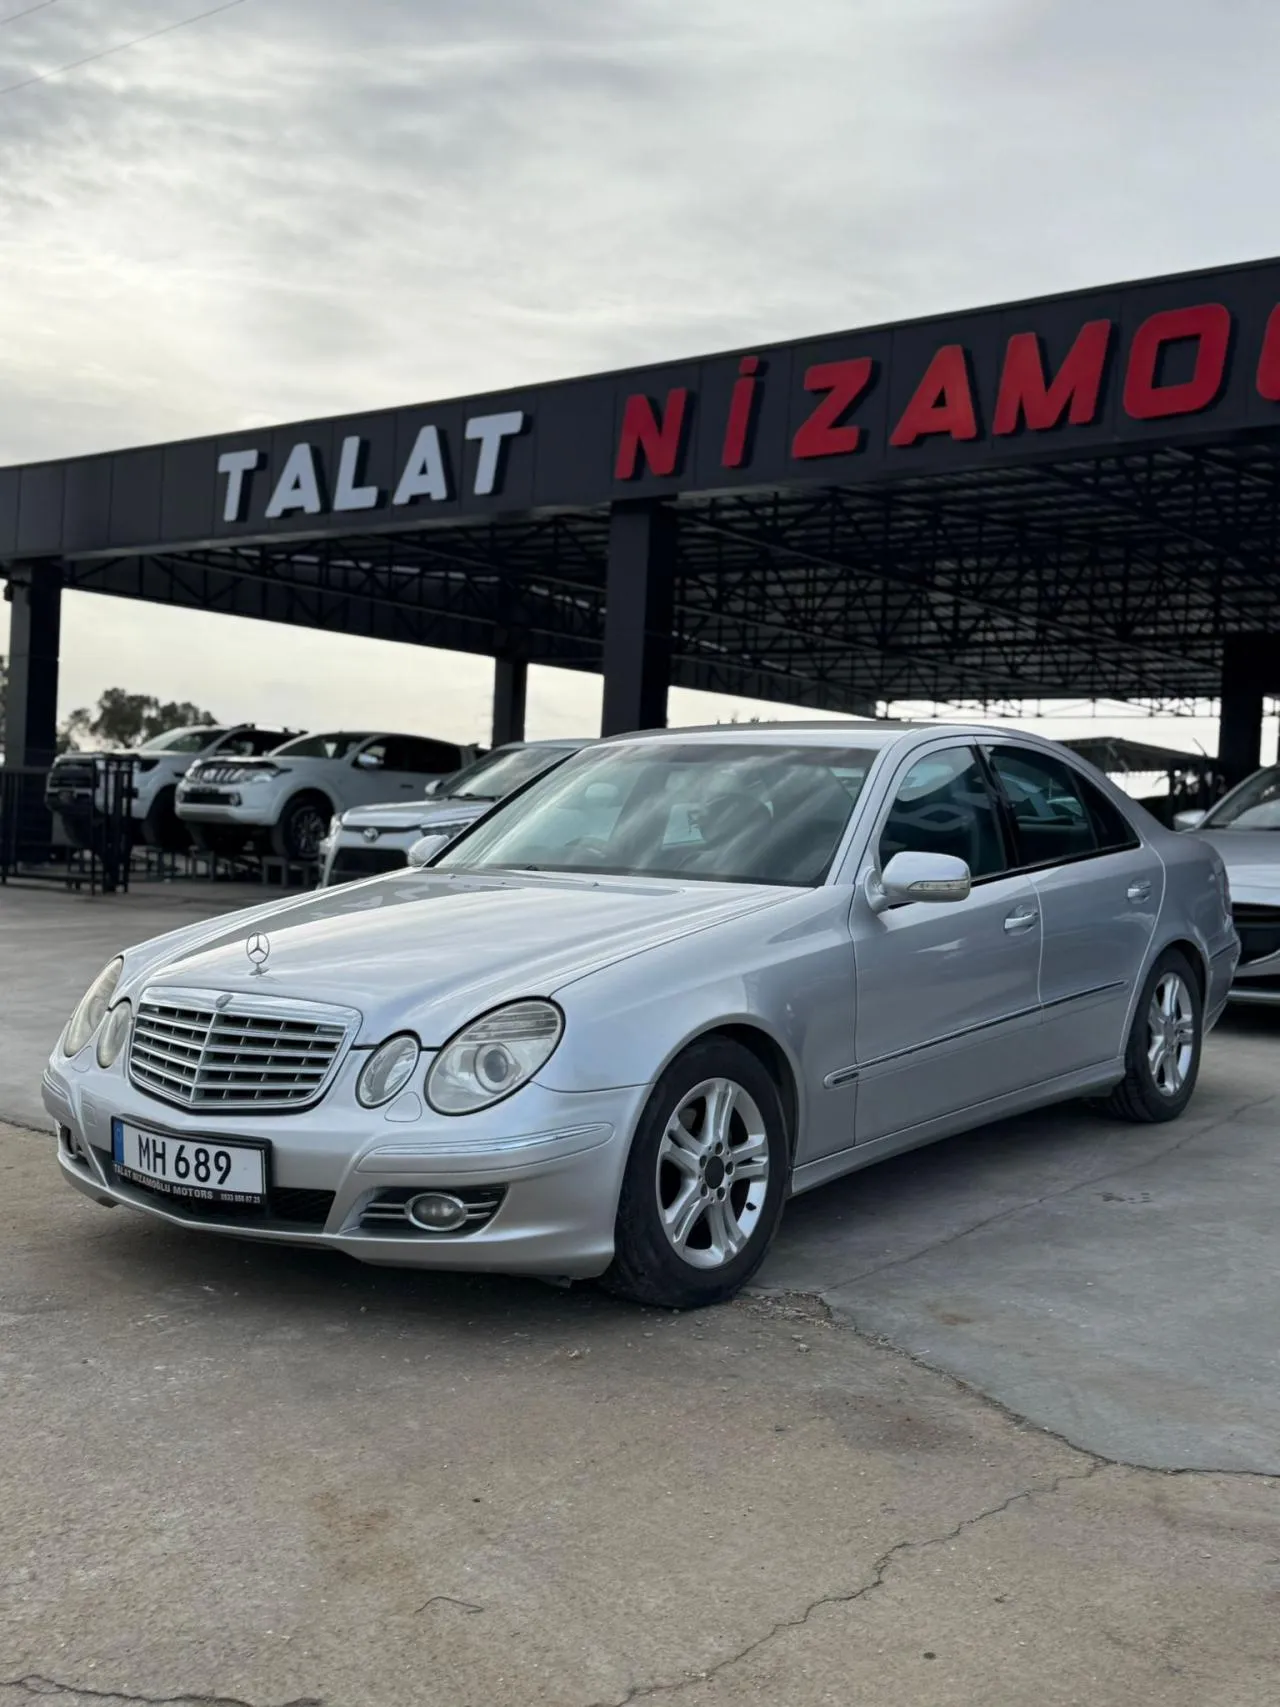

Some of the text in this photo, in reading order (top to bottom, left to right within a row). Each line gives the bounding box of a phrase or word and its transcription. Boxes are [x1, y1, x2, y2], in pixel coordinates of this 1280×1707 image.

[218, 302, 1280, 522] TALAT NİZAMO
[138, 1134, 232, 1185] MH 689
[173, 1186, 213, 1200] MOTORS
